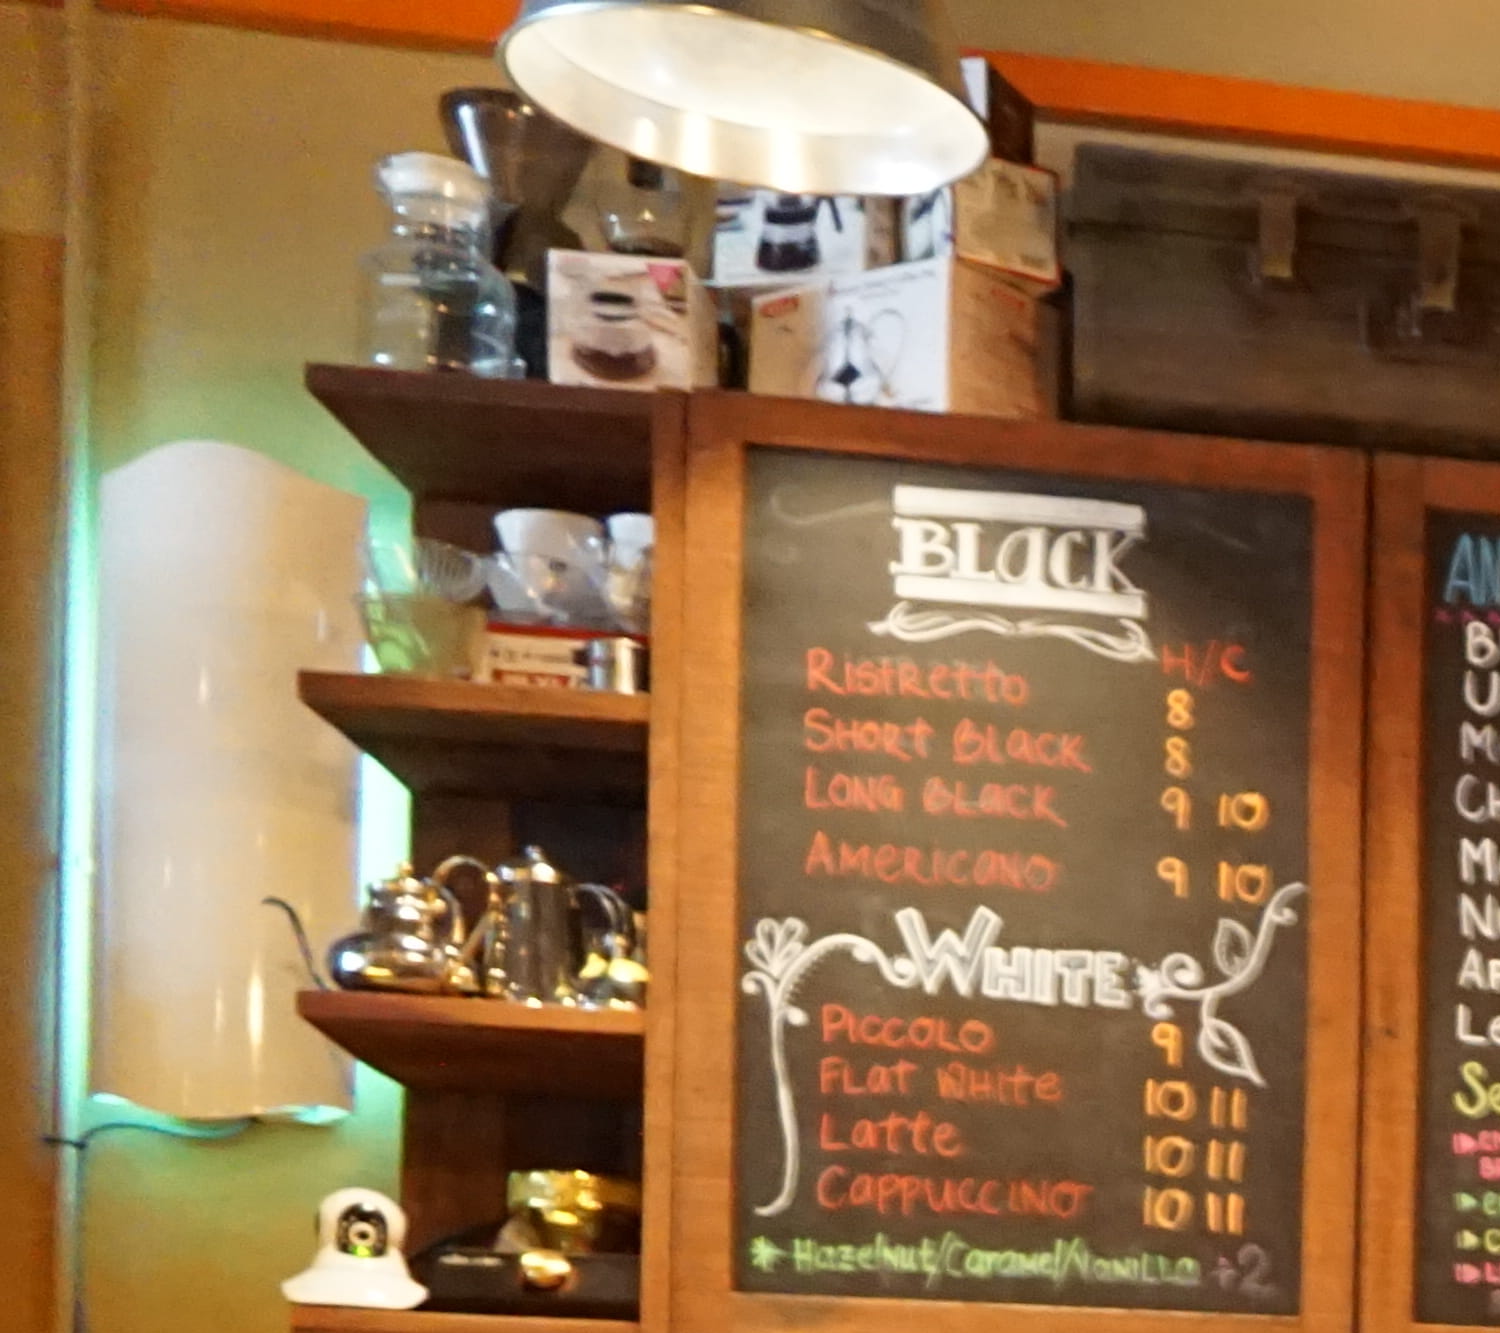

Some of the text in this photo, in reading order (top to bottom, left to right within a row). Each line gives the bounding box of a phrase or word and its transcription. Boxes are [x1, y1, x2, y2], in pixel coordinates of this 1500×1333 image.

[1161, 641, 1254, 685] H/C
[1167, 689, 1195, 730] 8
[1164, 736, 1192, 780] 8
[1160, 787, 1191, 830] 9
[1217, 791, 1270, 830] 10
[1156, 857, 1269, 904] 9 10
[896, 905, 1133, 1010] WHITE
[1150, 1023, 1184, 1069] 9
[1144, 1077, 1196, 1122] 10
[1208, 1086, 1248, 1132] 11
[1143, 1135, 1195, 1179] 10
[1206, 1138, 1246, 1184] 11
[1142, 1185, 1246, 1236] 10 11
